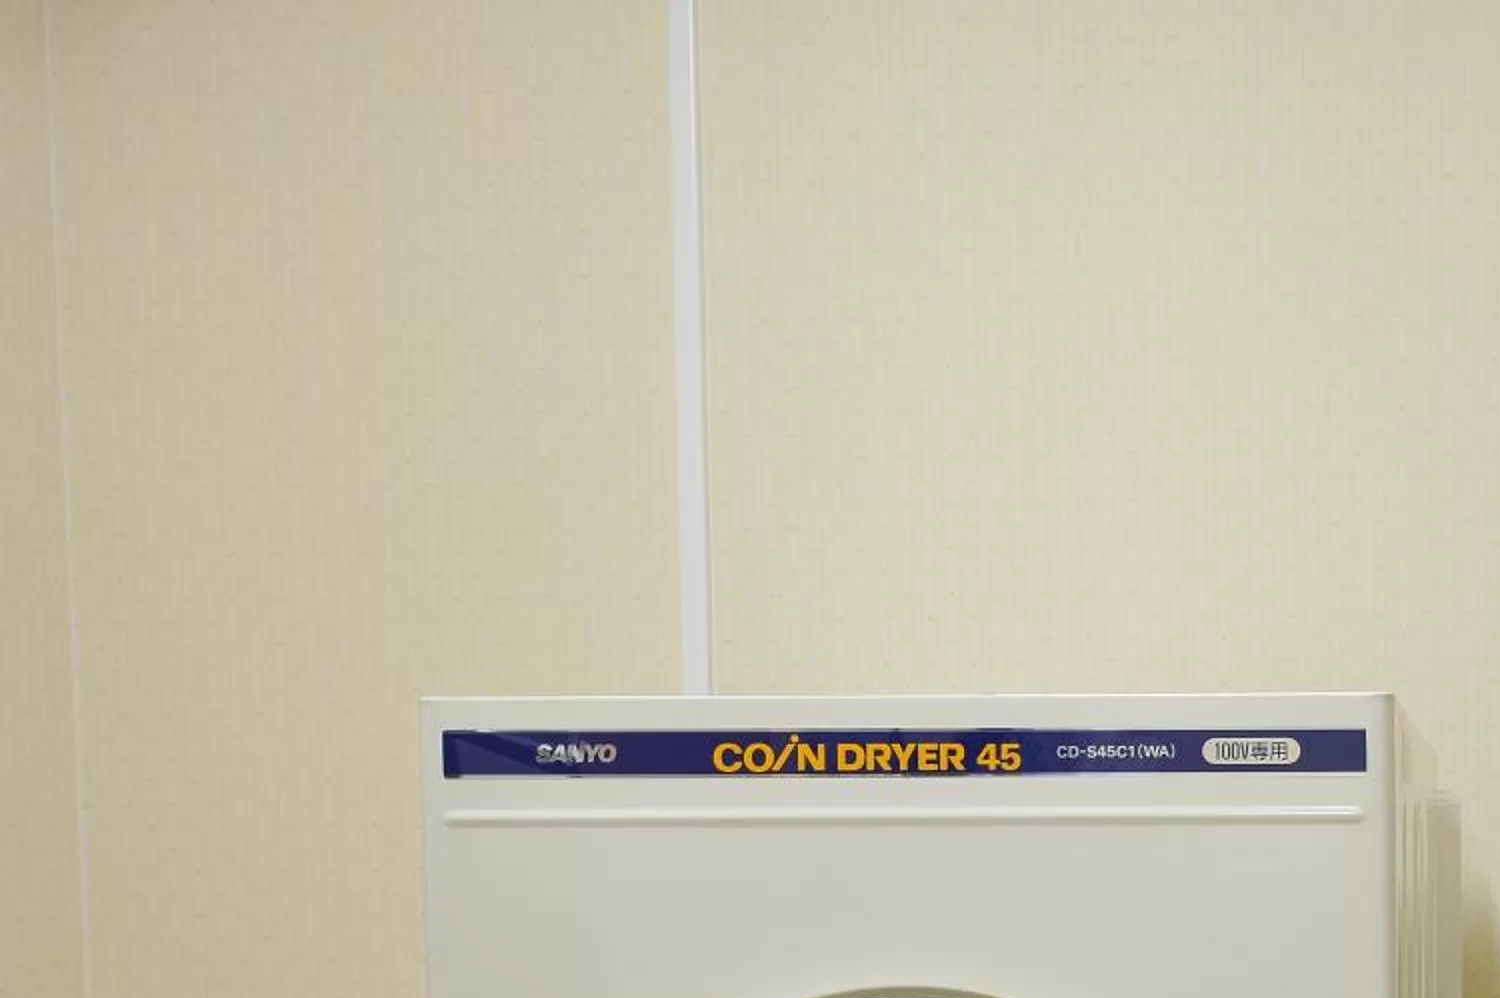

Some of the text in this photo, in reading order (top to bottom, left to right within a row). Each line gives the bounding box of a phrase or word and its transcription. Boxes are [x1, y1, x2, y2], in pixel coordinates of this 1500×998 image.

[536, 743, 617, 767] SANYO
[713, 735, 1022, 772] COIN DRYER 45
[1056, 743, 1176, 761] CD-S45C1(WA)
[1214, 741, 1288, 761] 100V専用
